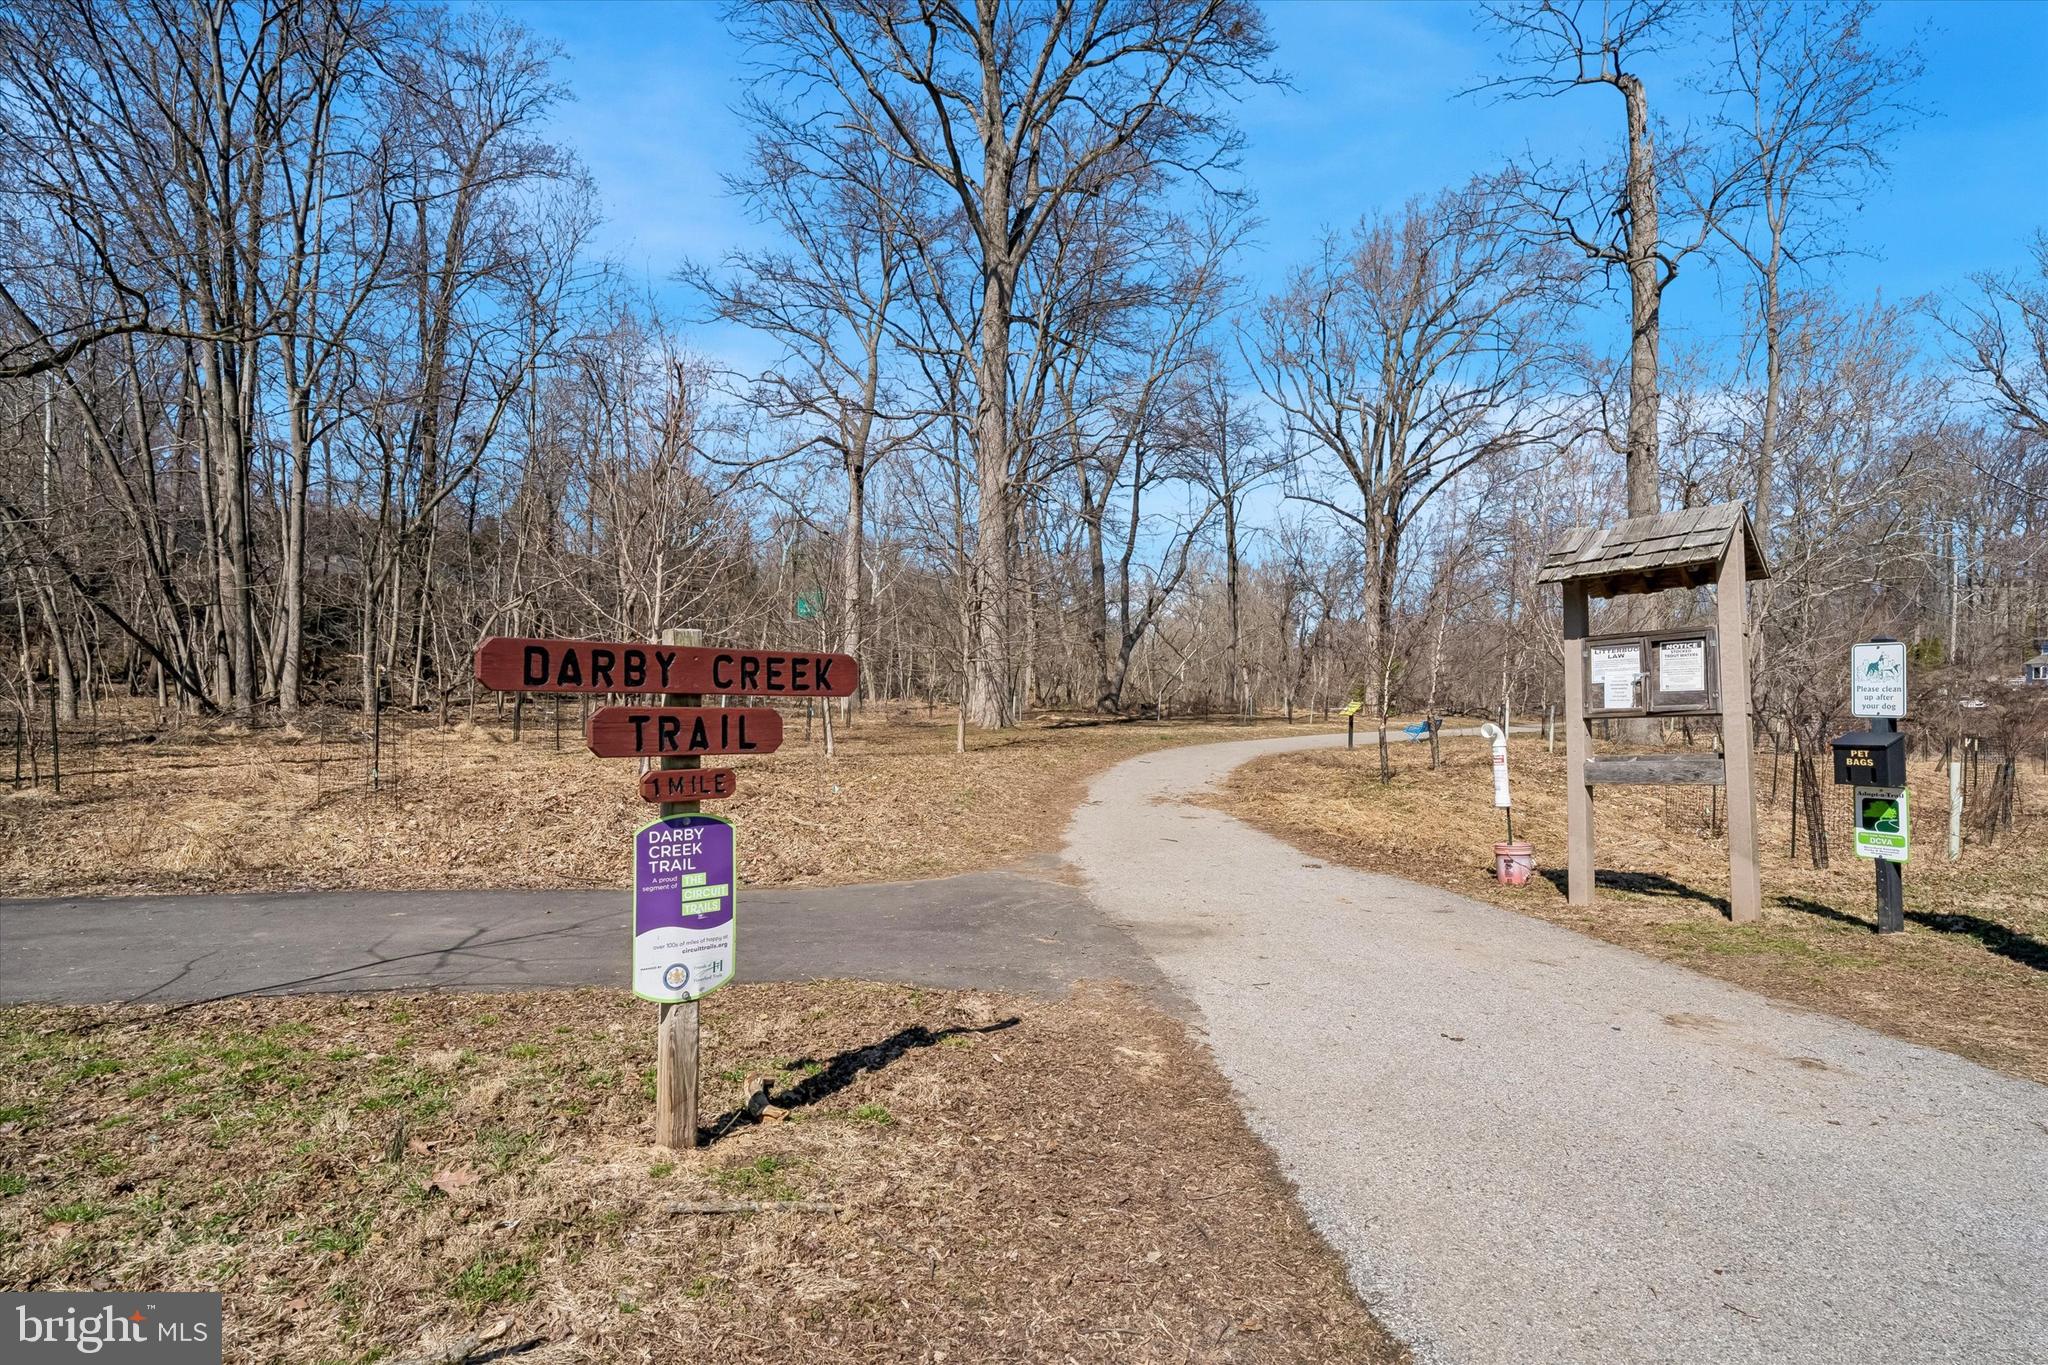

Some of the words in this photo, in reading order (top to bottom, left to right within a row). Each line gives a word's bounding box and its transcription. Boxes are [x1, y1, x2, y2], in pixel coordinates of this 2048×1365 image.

[523, 645, 677, 688] DARBY
[713, 654, 833, 690] CREEK
[1856, 685, 1880, 693] Please
[1881, 685, 1902, 693] clean
[1881, 703, 1896, 711] dog
[628, 714, 757, 751] TRAIL
[1846, 758, 1874, 766] BAGS
[652, 778, 660, 797] 1
[669, 773, 728, 796] MILE
[649, 828, 704, 844] DARBY
[649, 842, 703, 858] CREEK
[649, 858, 696, 873] TRAIL
[658, 876, 678, 884] proud
[685, 875, 704, 885] THE
[642, 884, 670, 892] segment
[684, 886, 727, 899] CIRCUIT
[684, 900, 718, 913] TRAILS
[682, 942, 728, 954] circuittrails.org
